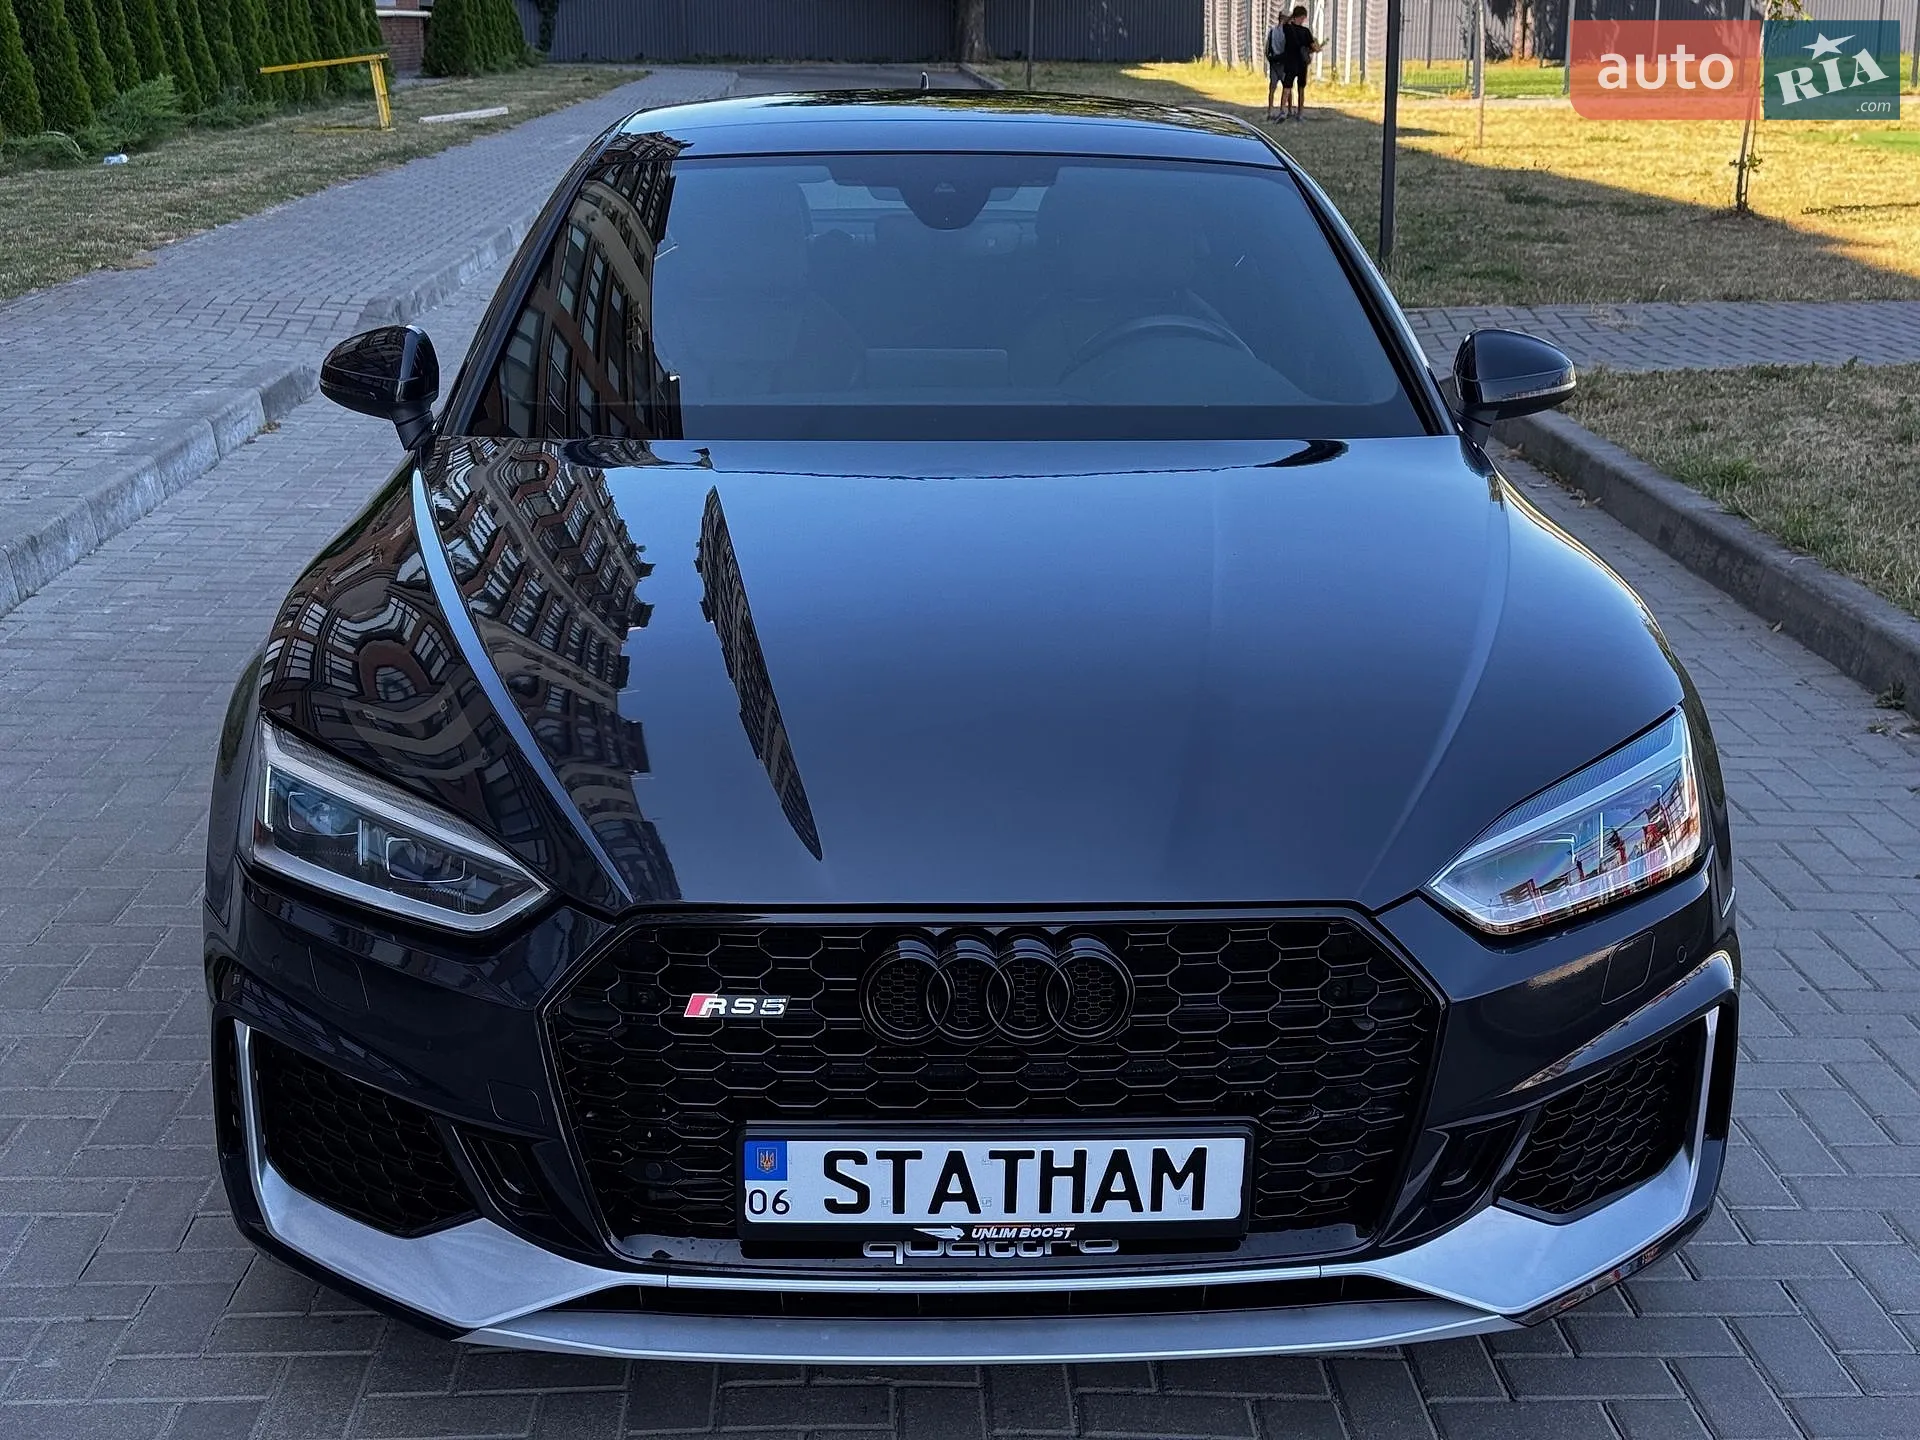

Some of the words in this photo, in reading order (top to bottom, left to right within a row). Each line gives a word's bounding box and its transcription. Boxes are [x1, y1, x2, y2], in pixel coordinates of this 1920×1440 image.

[699, 997, 787, 1016] RS5
[823, 1146, 1208, 1215] STATHAM
[748, 1189, 791, 1216] 06
[971, 1226, 1017, 1240] UNLIM
[1018, 1226, 1075, 1240] BOOST
